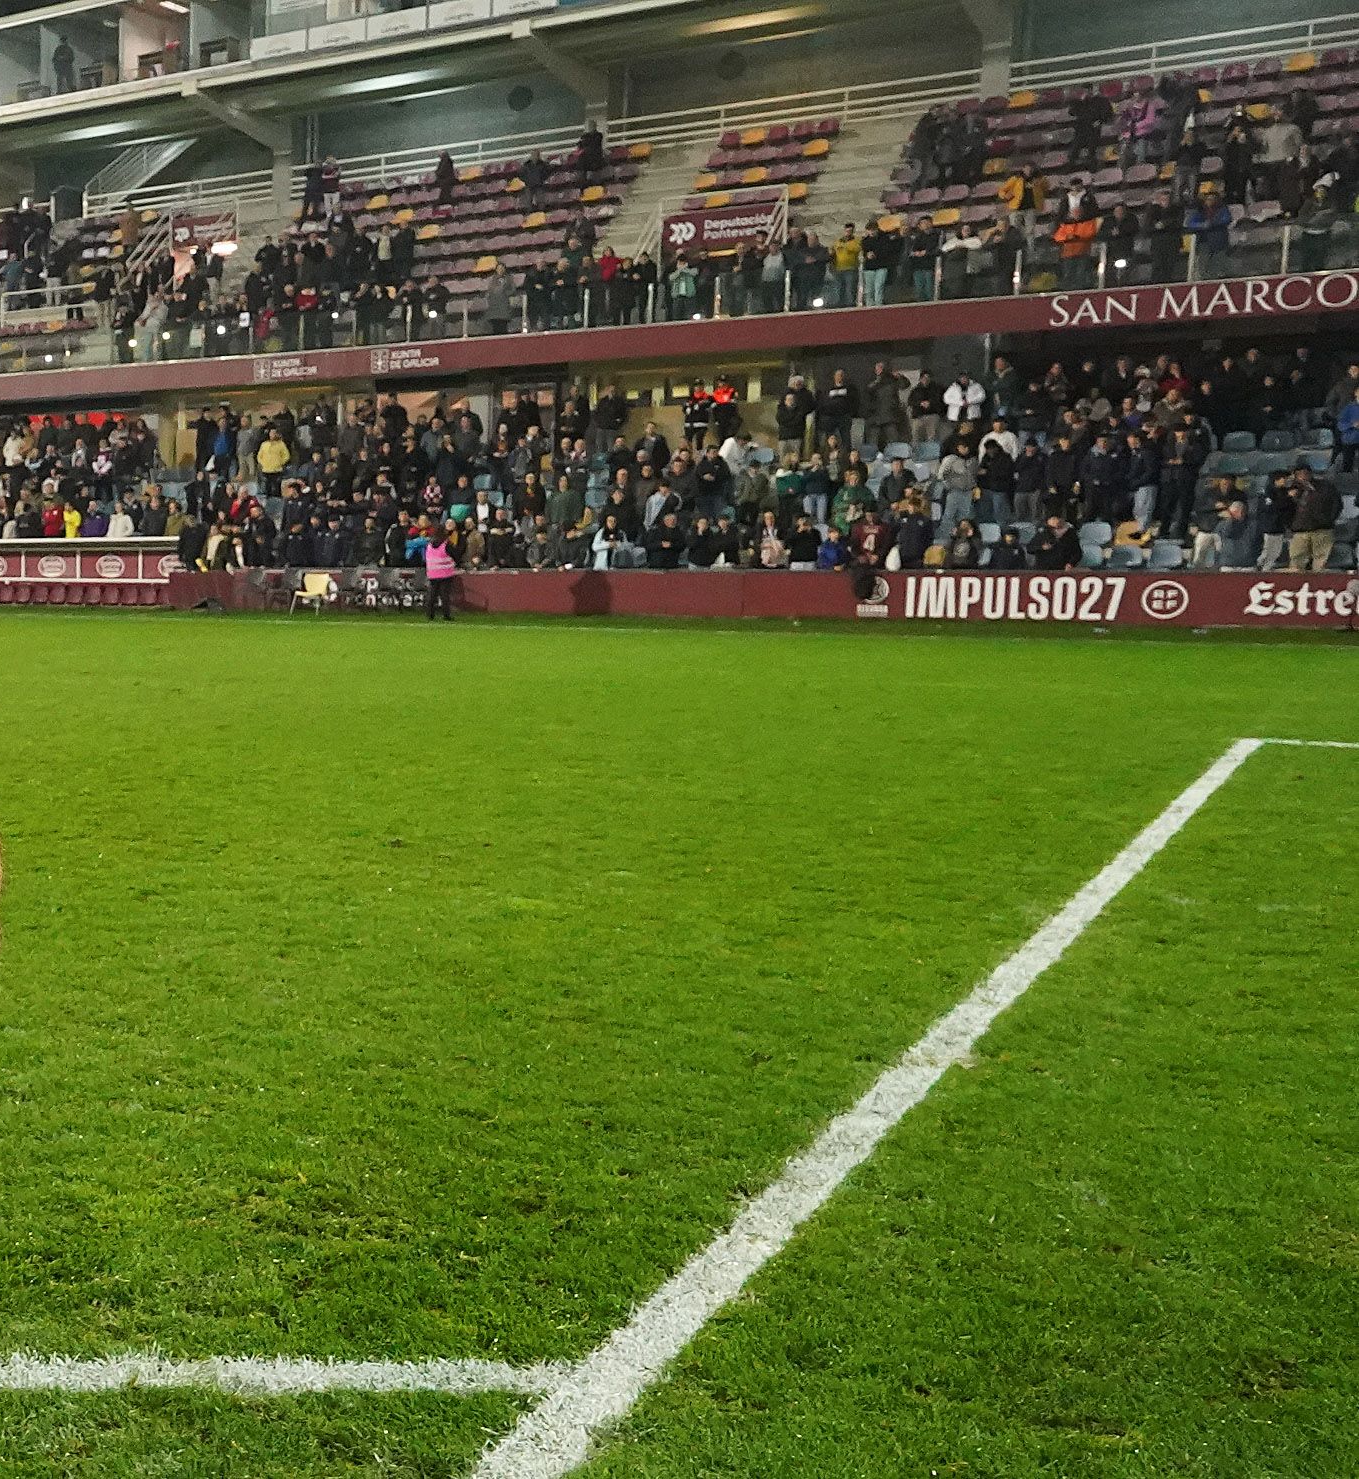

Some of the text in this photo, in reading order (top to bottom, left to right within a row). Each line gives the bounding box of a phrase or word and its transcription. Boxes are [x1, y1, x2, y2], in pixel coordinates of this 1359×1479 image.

[1049, 272, 1359, 327] SAN MARCO
[904, 575, 1127, 621] IMPULSO27
